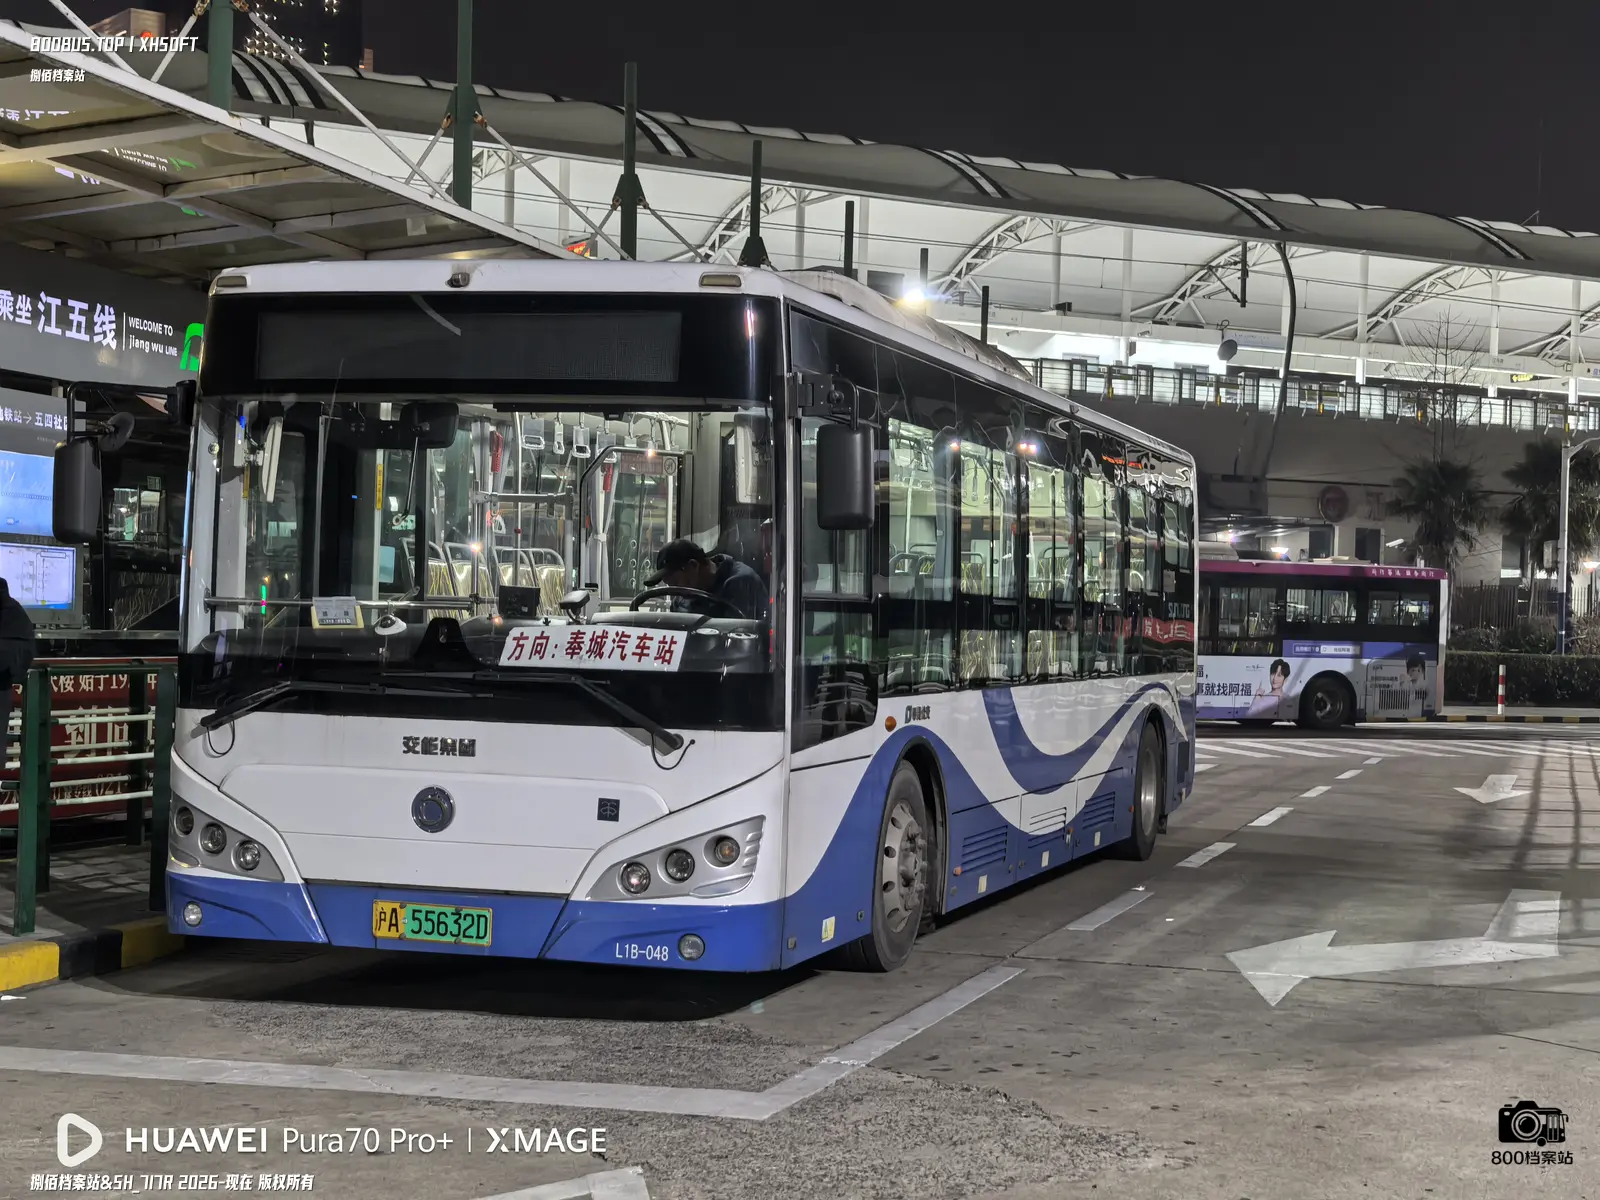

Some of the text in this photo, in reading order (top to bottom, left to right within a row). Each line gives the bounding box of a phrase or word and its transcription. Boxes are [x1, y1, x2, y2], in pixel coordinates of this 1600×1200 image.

[0, 289, 117, 350] 乘坐 江五线
[128, 316, 174, 337] WELCOME TO
[129, 334, 178, 357] jiang wu LINE
[374, 906, 489, 940] 沪A 55632D
[615, 942, 669, 962] L1B-048
